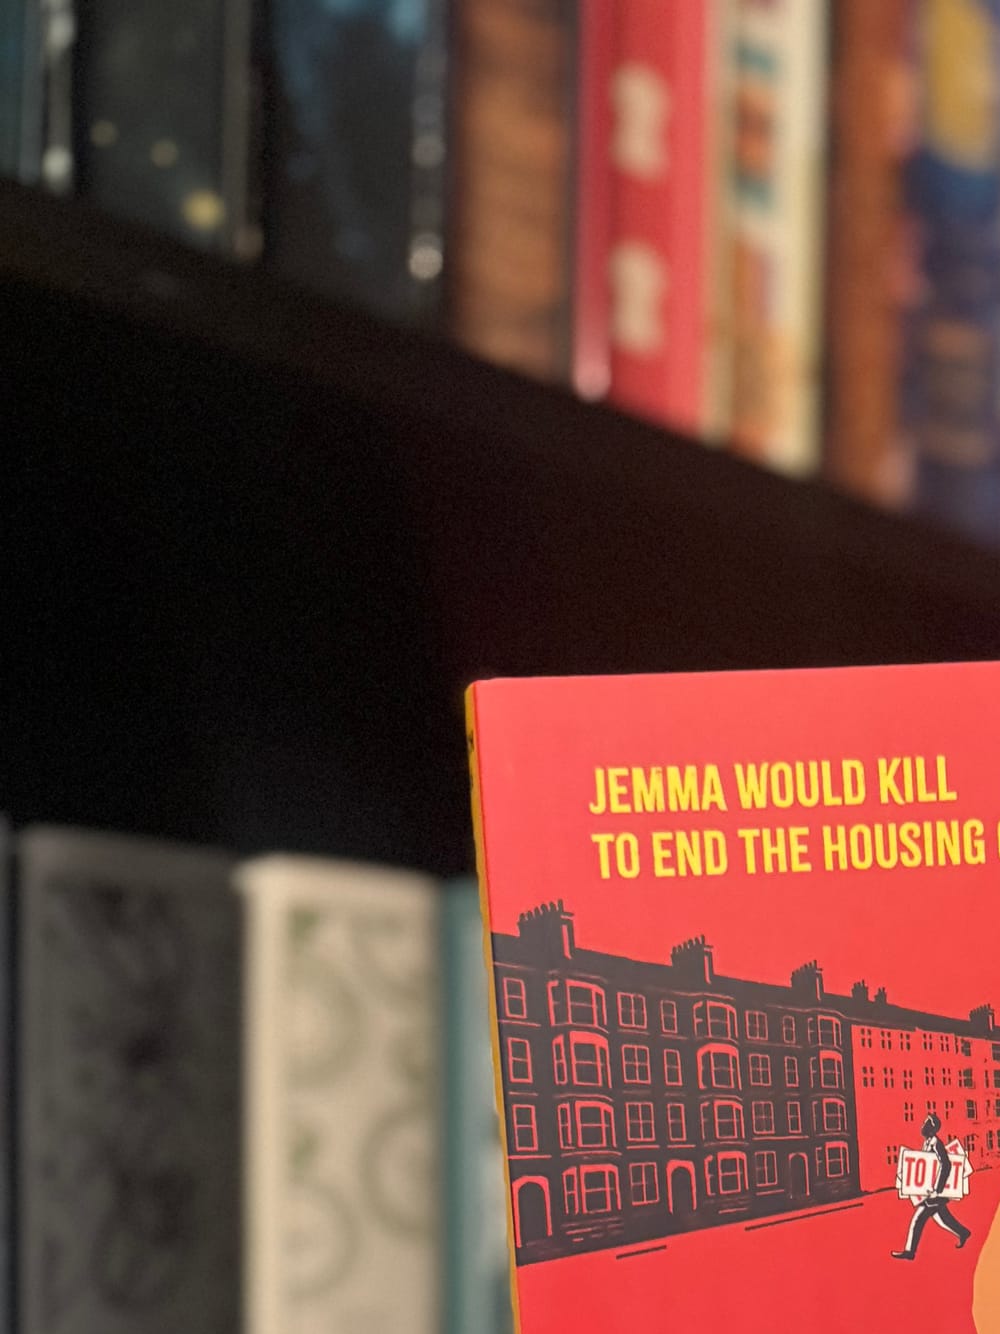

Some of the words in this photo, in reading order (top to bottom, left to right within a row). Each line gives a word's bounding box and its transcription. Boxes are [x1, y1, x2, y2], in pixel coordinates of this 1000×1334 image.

[588, 763, 728, 815] JEMMA
[733, 759, 866, 810] WOULD
[877, 754, 958, 805] KILL
[590, 831, 641, 880] TO
[651, 829, 728, 878] END
[737, 826, 812, 875] THE
[822, 818, 986, 871] HOUSING
[904, 1156, 927, 1188] TO
